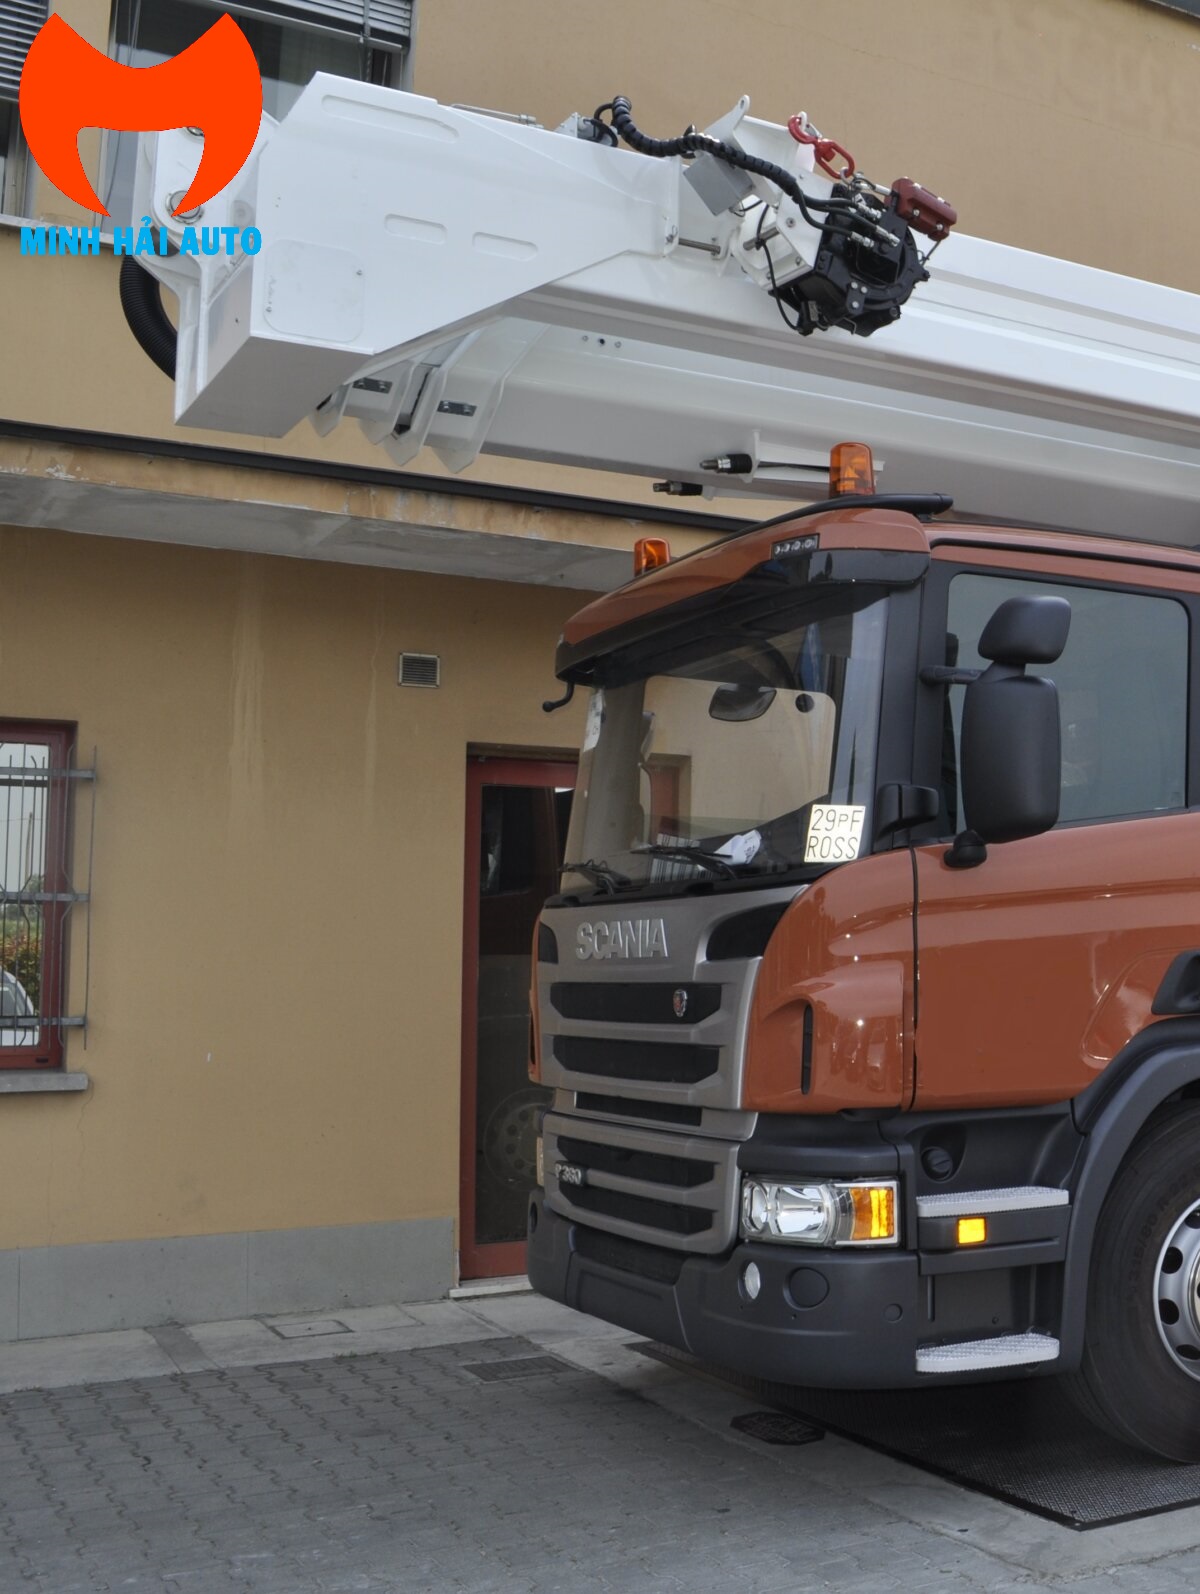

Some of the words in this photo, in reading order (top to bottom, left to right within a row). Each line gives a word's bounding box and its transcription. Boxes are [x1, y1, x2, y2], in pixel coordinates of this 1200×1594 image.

[811, 808, 864, 832] 29PF
[806, 835, 859, 860] ROSS
[576, 918, 669, 961] SCANIA
